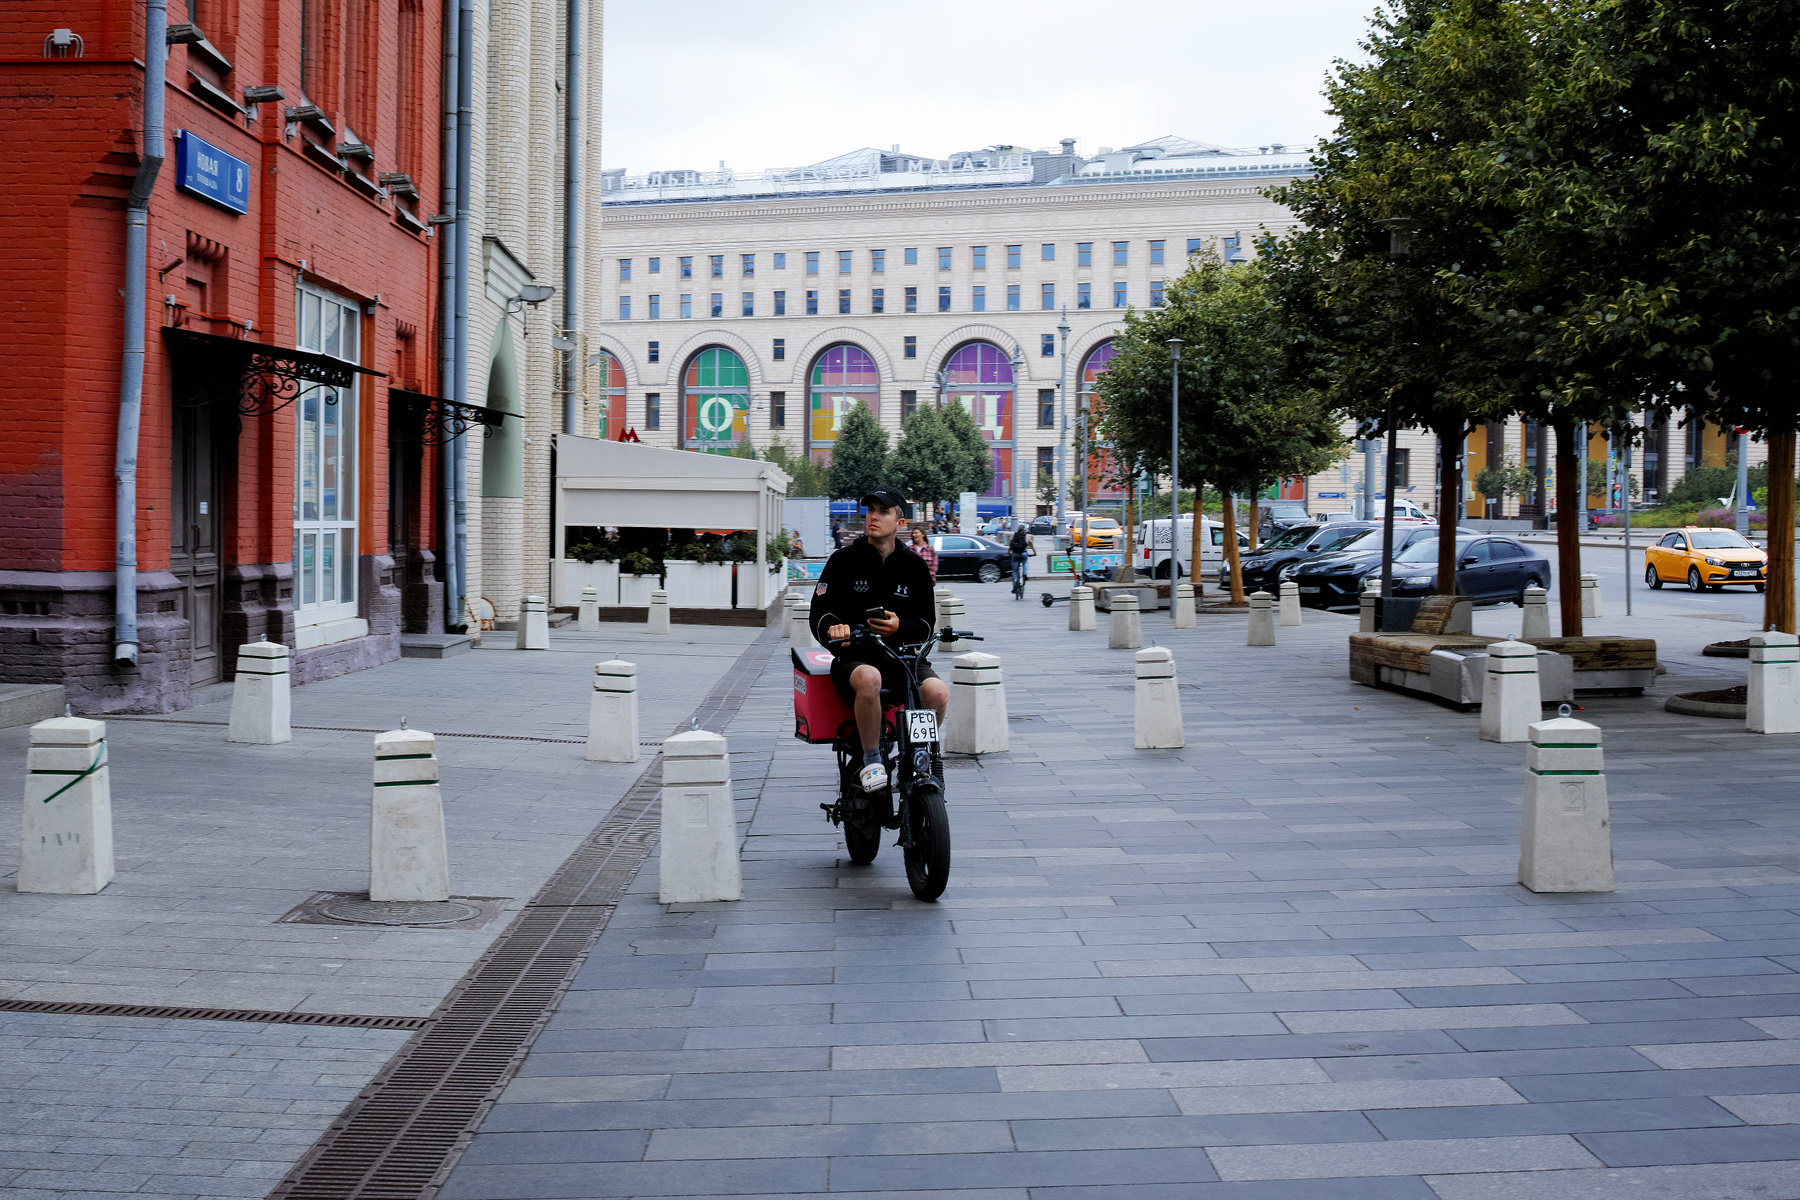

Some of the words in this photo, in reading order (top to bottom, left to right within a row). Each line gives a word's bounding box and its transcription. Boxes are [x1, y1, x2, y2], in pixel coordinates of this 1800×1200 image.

[197, 151, 218, 176] НОВАЯ
[908, 154, 1032, 174] МАГАЗИН
[236, 168, 243, 192] 8
